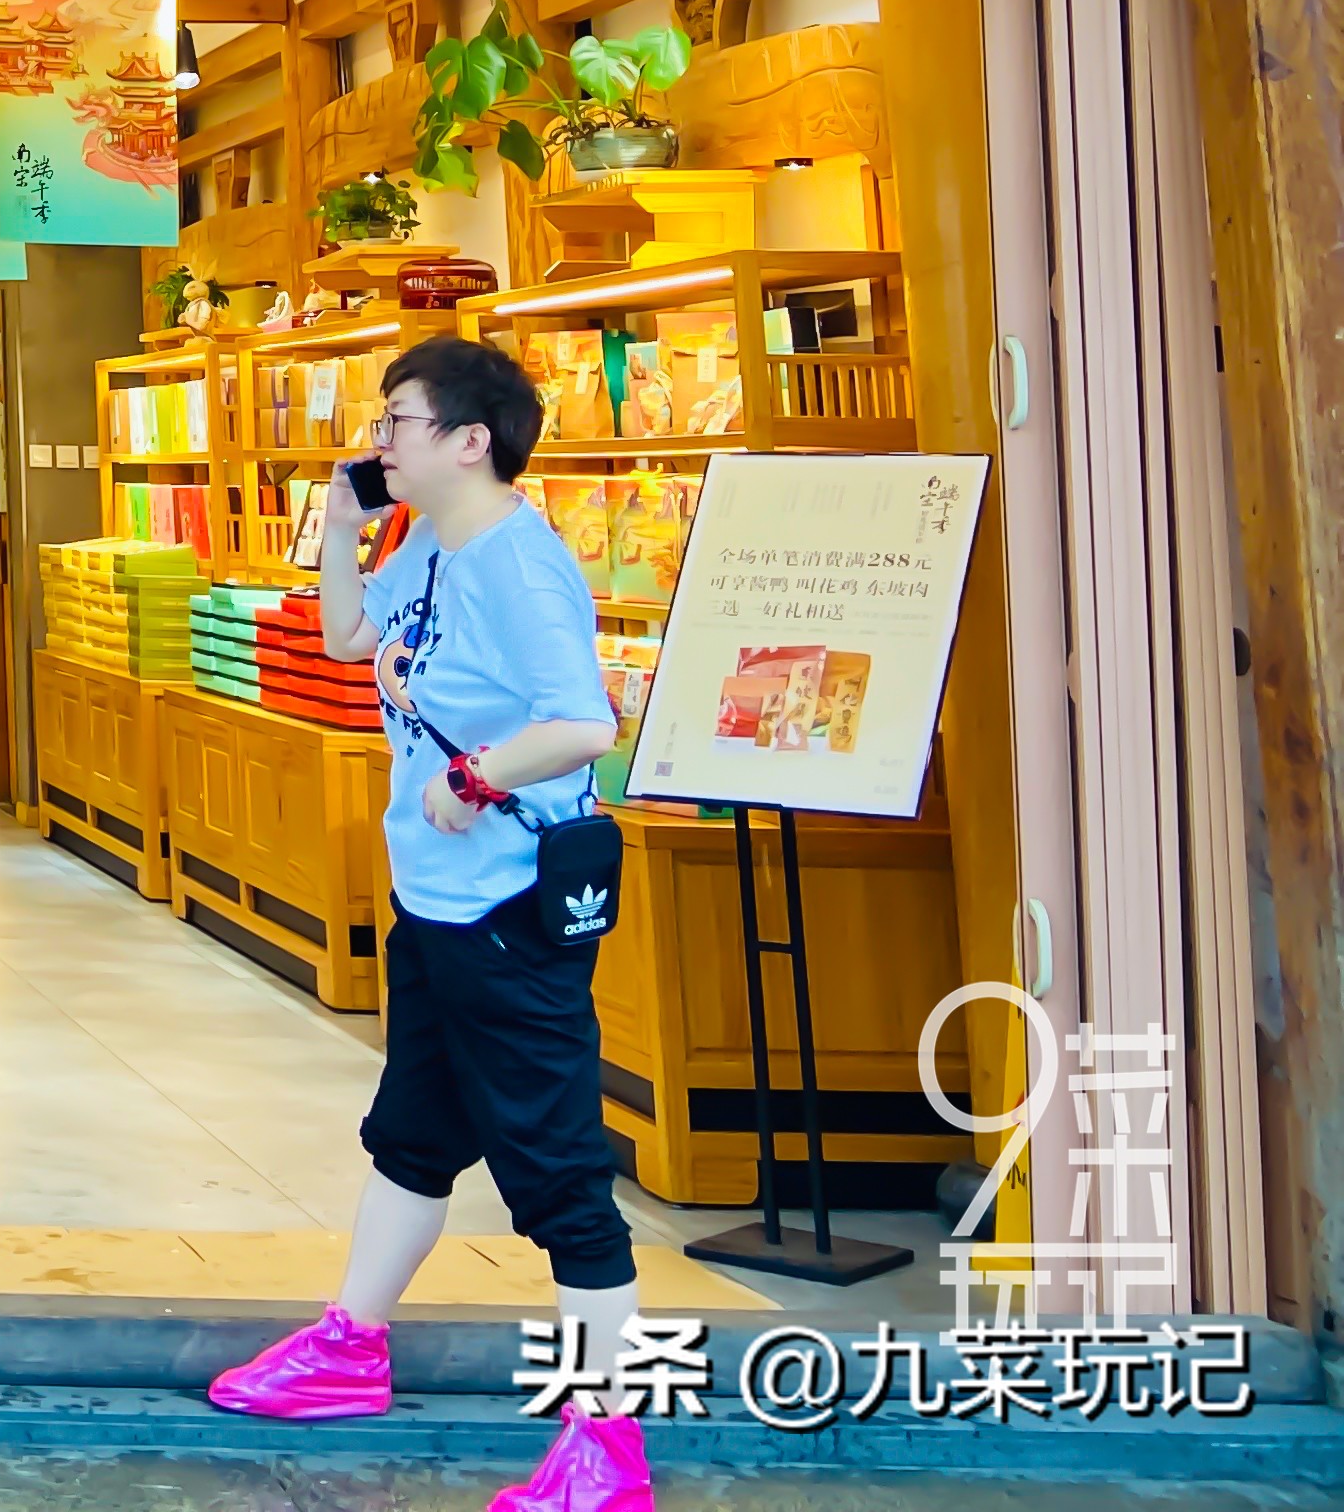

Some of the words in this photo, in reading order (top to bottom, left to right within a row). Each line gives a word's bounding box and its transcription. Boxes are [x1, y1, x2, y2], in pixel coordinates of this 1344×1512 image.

[30, 154, 55, 225] 端午季
[564, 917, 607, 936] adidas
